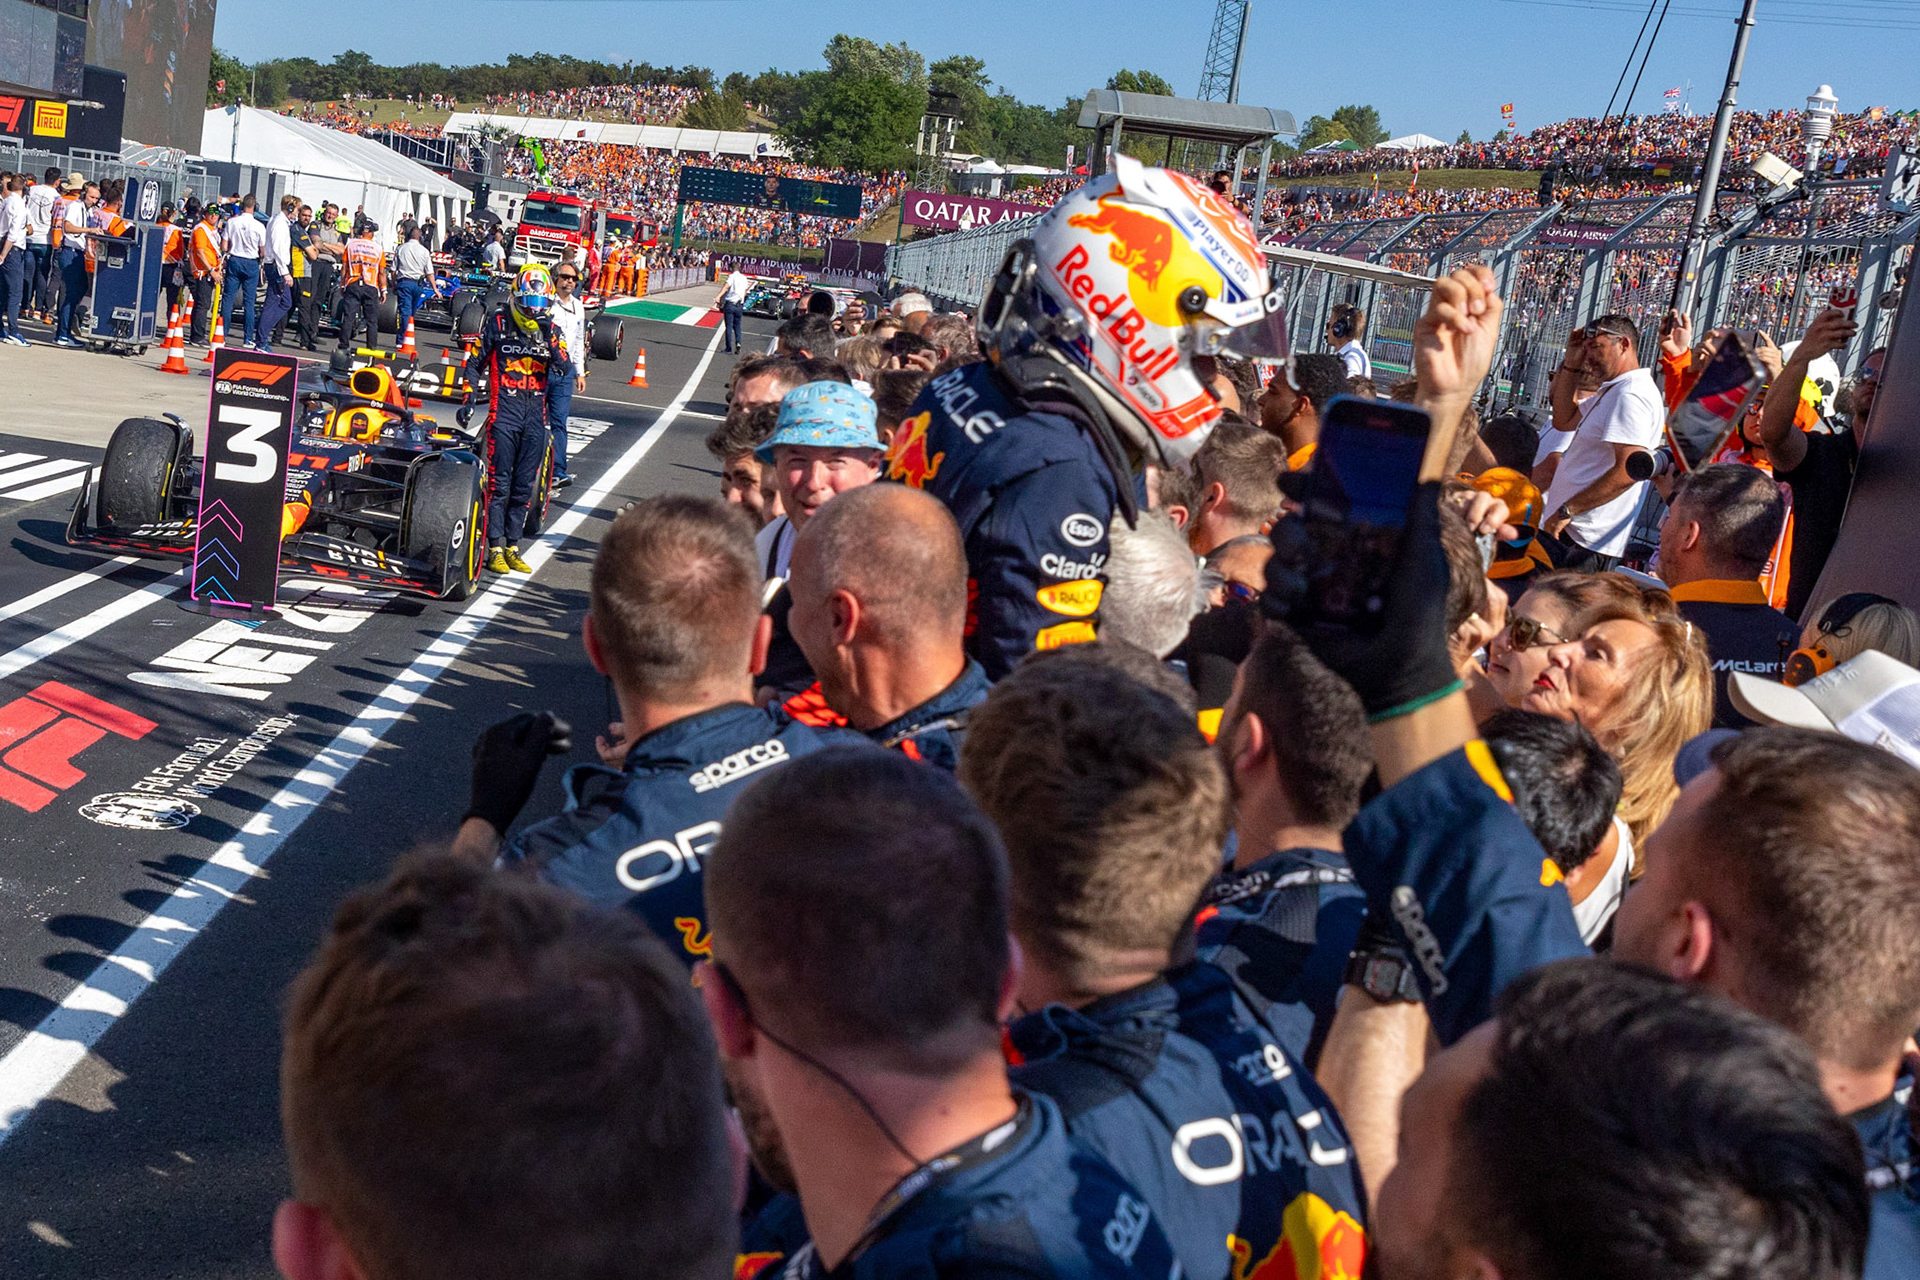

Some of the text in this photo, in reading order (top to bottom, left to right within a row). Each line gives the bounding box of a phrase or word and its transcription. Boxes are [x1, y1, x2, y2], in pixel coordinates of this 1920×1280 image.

[37, 105, 65, 130] PIRELLI
[915, 199, 991, 226] QATAR
[1191, 218, 1236, 267] Player
[721, 254, 803, 271] QATAR AIRWAYS
[1056, 243, 1180, 381] Red Bull
[242, 385, 265, 394] Formula
[501, 373, 527, 389] Red
[232, 389, 287, 402] World Championship
[214, 404, 282, 484] 3
[1040, 553, 1098, 579] Claro
[1711, 658, 1787, 674] McLare
[156, 741, 222, 775] Formula
[172, 717, 296, 798] World Championship
[689, 739, 788, 789] sparco
